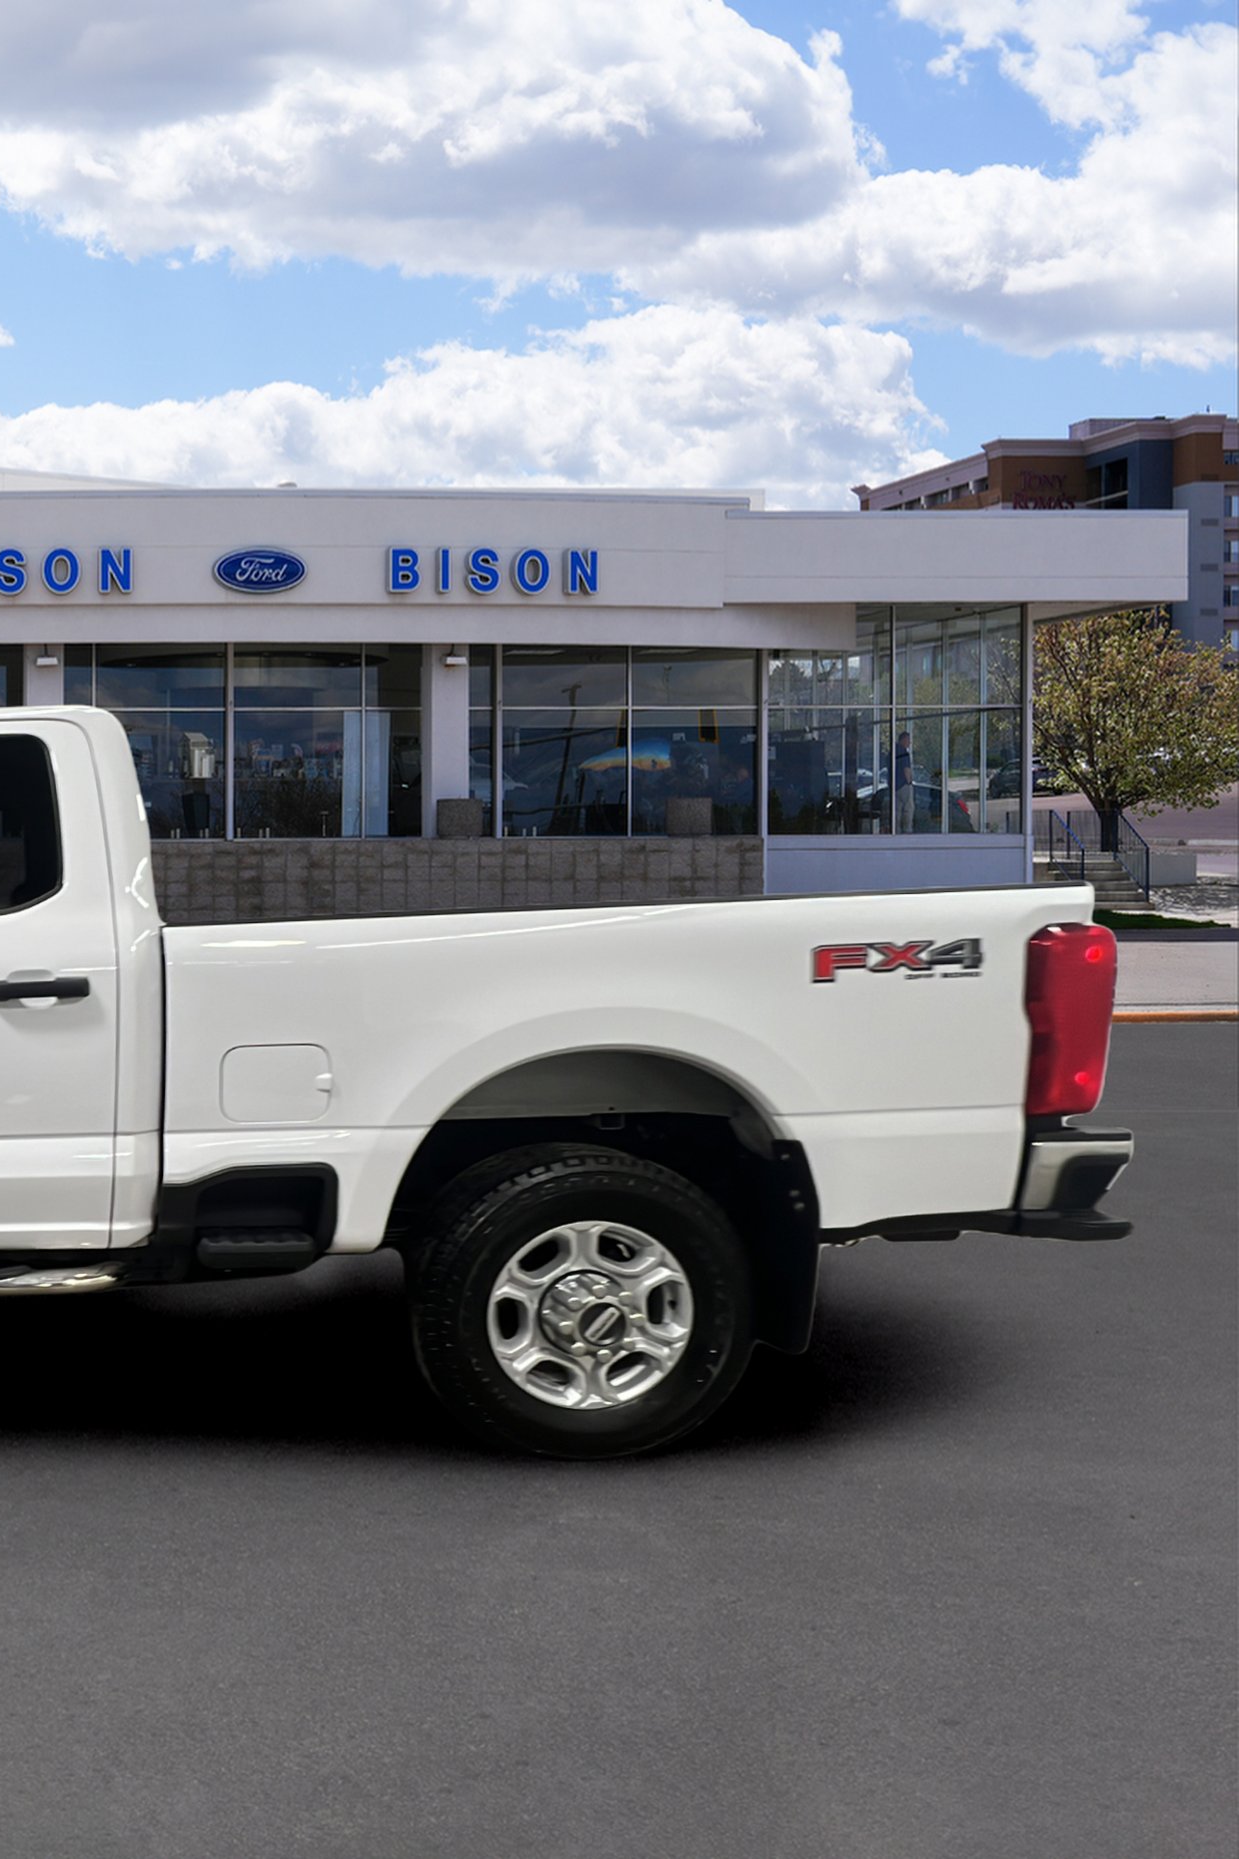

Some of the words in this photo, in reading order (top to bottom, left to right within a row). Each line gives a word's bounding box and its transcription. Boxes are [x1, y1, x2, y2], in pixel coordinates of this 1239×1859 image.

[235, 556, 289, 583] Ford
[386, 546, 599, 595] BISON
[811, 938, 982, 983] FX4
